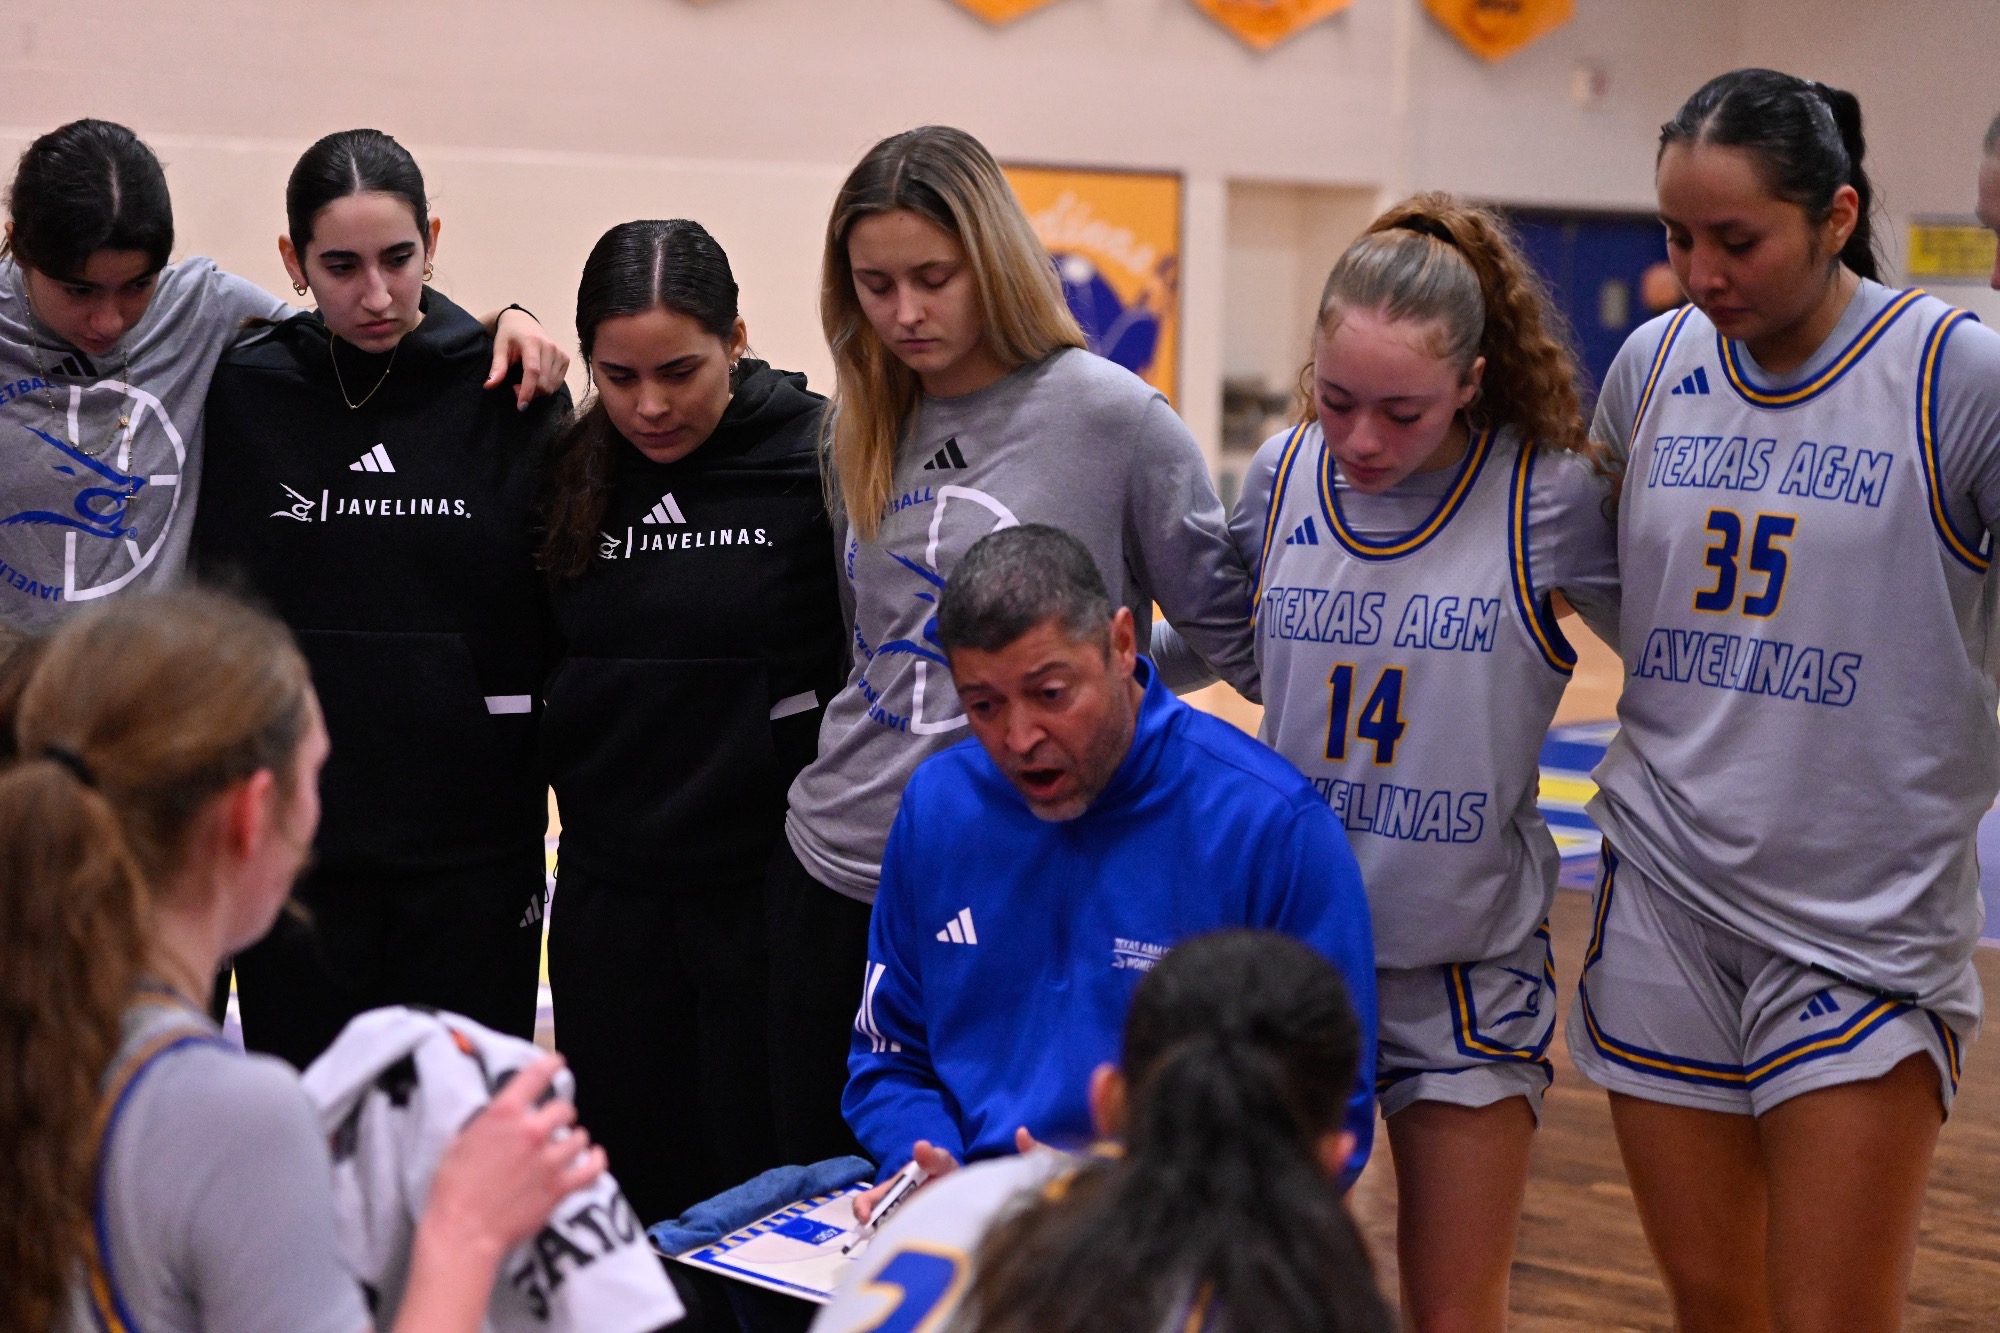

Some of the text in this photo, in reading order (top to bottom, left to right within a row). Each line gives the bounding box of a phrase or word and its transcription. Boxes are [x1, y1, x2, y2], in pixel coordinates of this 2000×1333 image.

[1649, 436, 1893, 507] TEXAS A&M
[1692, 506, 1798, 620] 35
[1267, 587, 1500, 652] TEXAS A&M
[1324, 662, 1409, 767] 14
